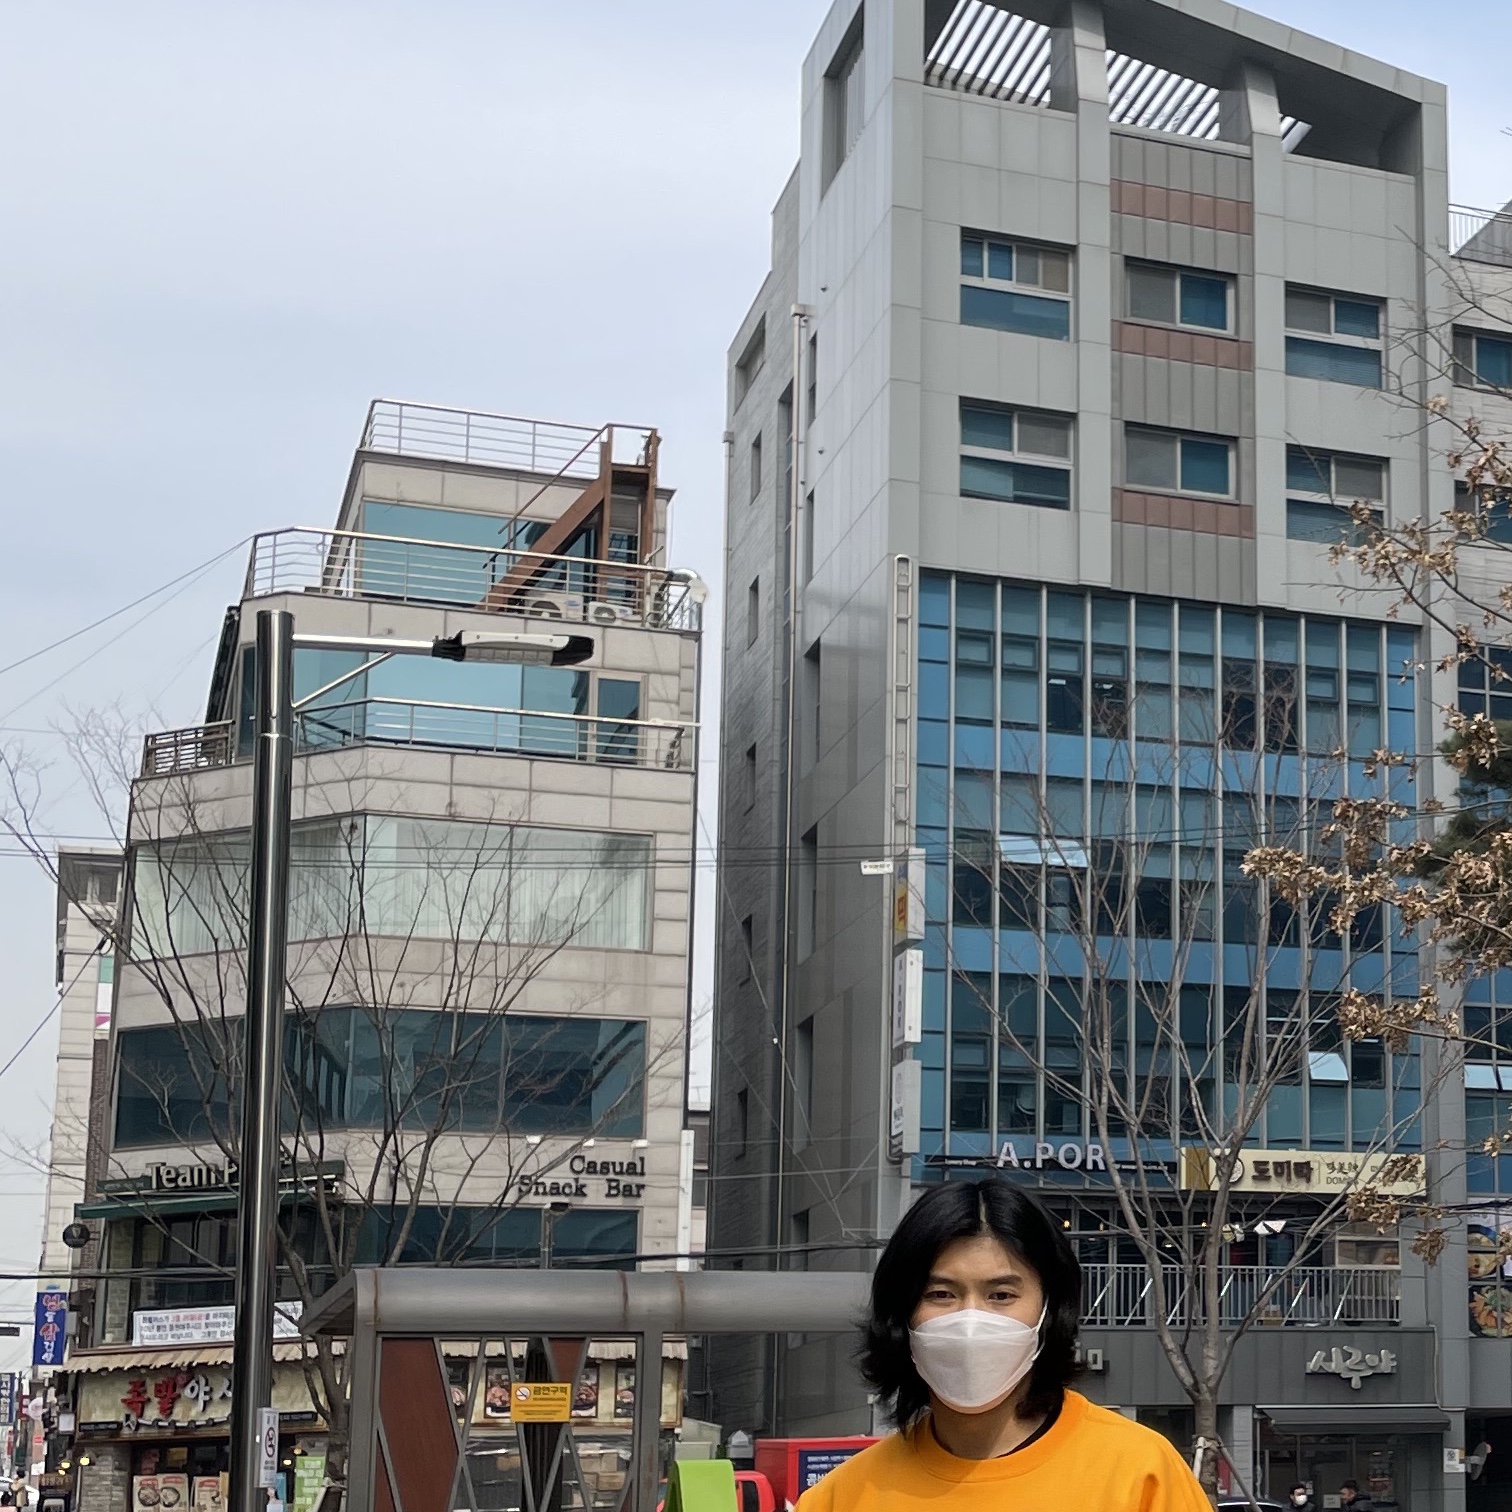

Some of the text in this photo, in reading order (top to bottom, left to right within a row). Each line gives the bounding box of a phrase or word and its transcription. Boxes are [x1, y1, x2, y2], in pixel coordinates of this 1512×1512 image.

[145, 1161, 218, 1190] Team
[569, 1155, 646, 1176] Casual
[518, 1175, 646, 1198] Snack Bar
[1308, 1345, 1397, 1390] 시루야
[121, 1373, 232, 1418] 족발야
[533, 1386, 568, 1396] 금연구역
